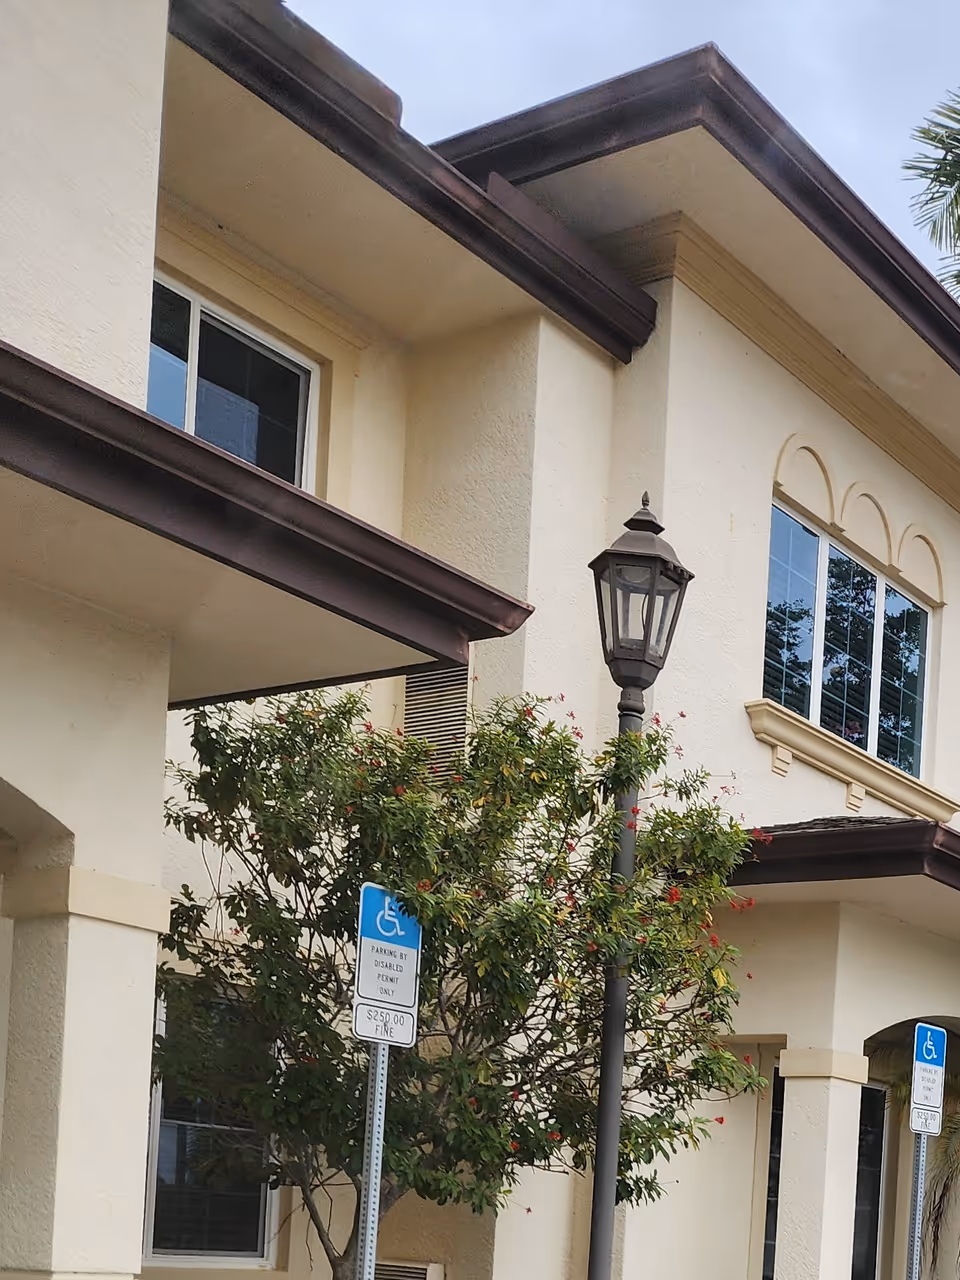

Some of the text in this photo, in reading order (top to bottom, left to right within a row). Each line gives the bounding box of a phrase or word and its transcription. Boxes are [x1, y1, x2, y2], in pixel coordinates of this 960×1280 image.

[371, 945, 408, 960] PARKING BY
[374, 959, 404, 973] DISABLED
[377, 973, 399, 985] PERMIT
[379, 986, 395, 997] ONLY
[366, 1009, 405, 1026] $250.00
[375, 1024, 394, 1038] FINE
